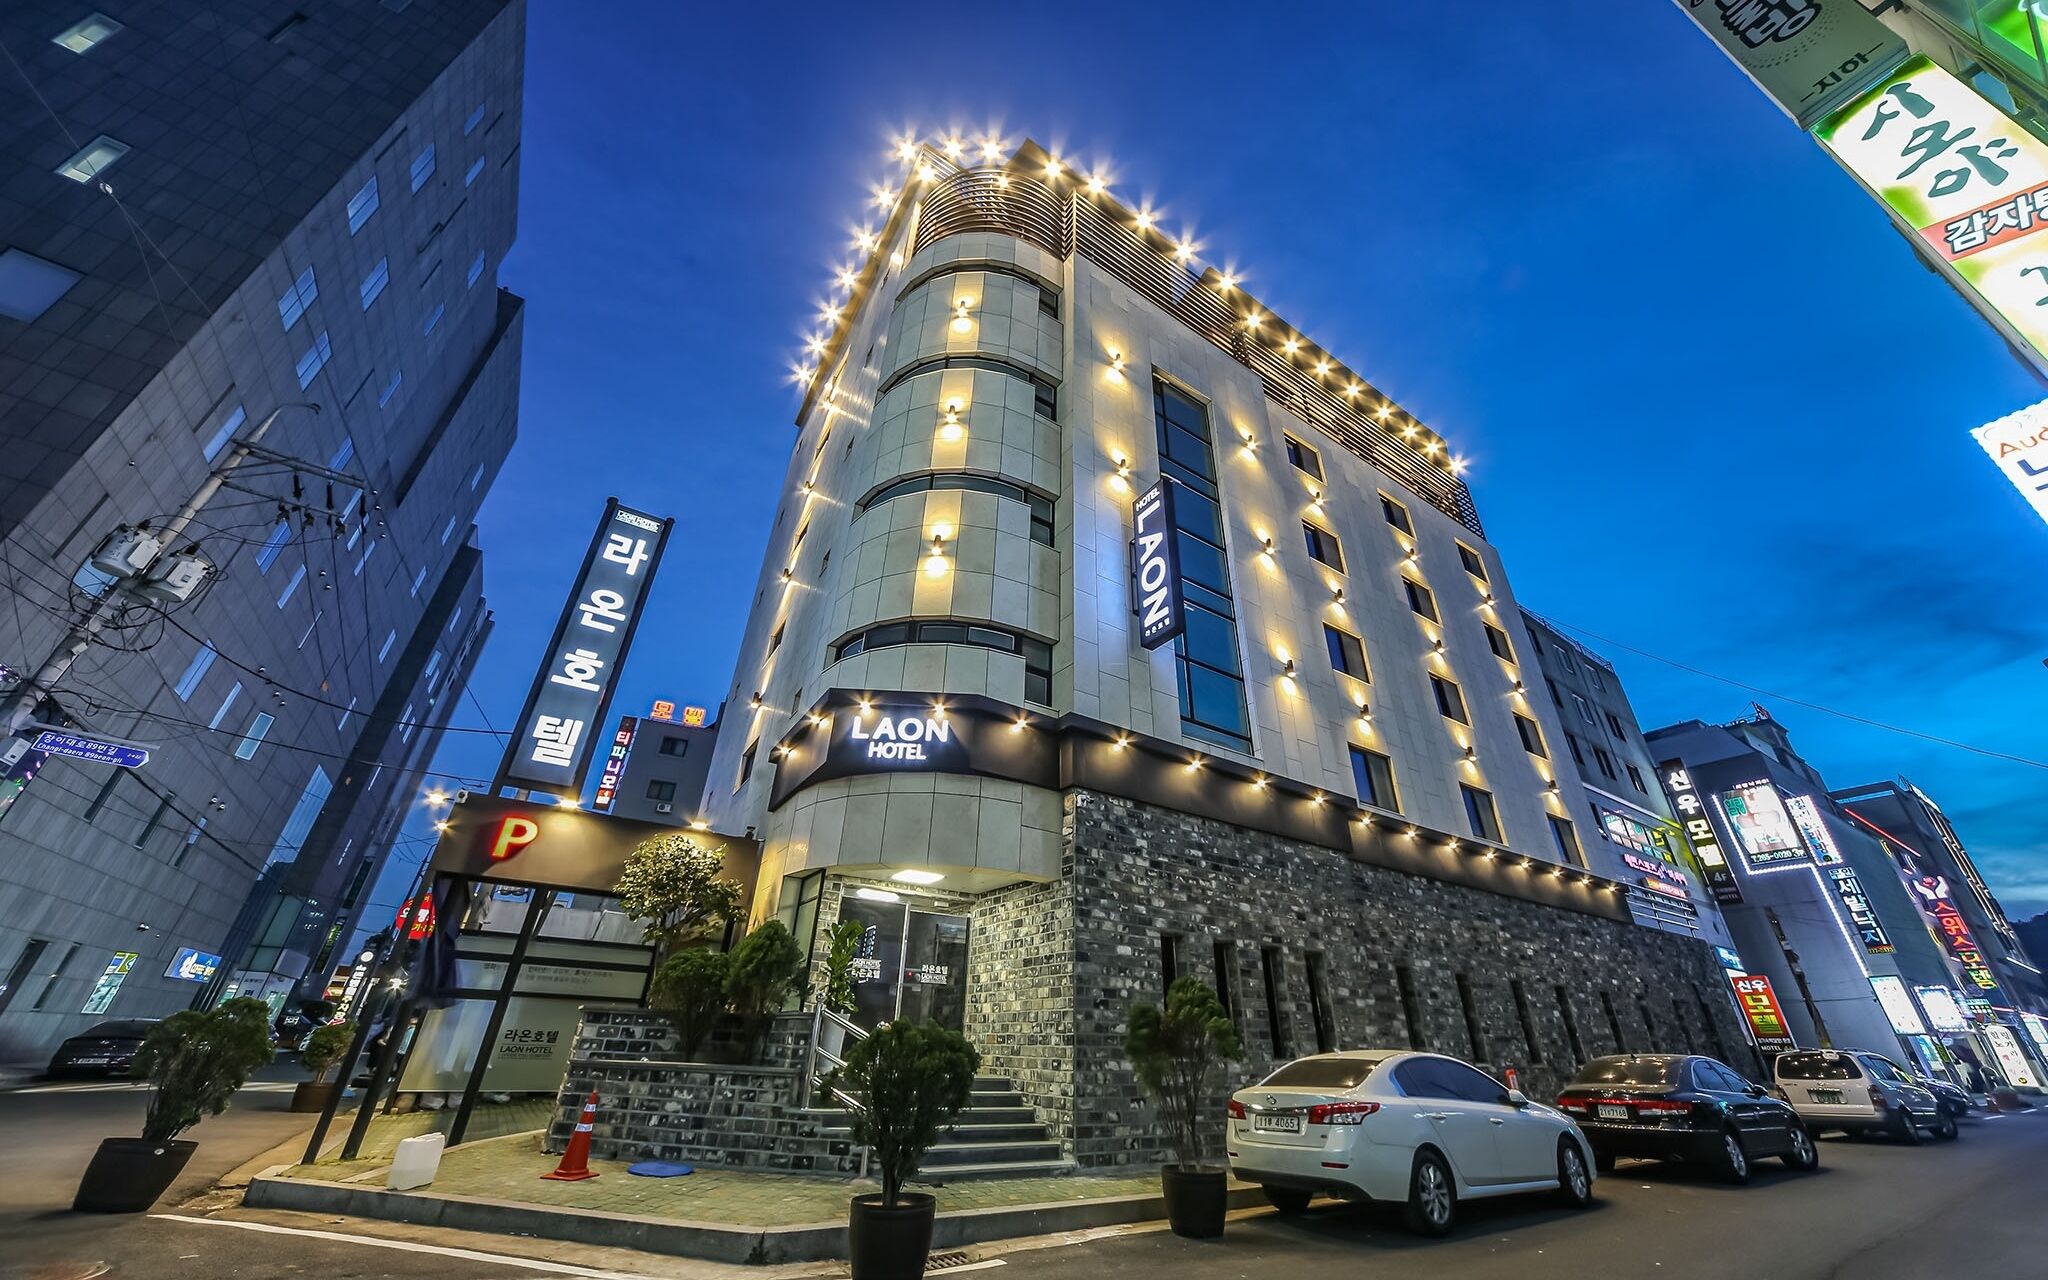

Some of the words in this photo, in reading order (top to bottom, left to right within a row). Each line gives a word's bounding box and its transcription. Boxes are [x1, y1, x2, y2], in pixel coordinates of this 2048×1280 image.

[1812, 52, 1869, 94] 지하
[1136, 488, 1160, 511] HOTEL
[1137, 500, 1170, 628] LAON
[531, 533, 648, 767] 라온호텔
[851, 715, 950, 742] LAON
[868, 741, 927, 760] HOTEL
[492, 817, 538, 857] P
[1737, 979, 1768, 993] 신우
[504, 1029, 559, 1045] 라온호텔
[500, 1045, 525, 1053] LAON
[525, 1046, 553, 1054] HOTEL
[1274, 1118, 1295, 1129] 4065
